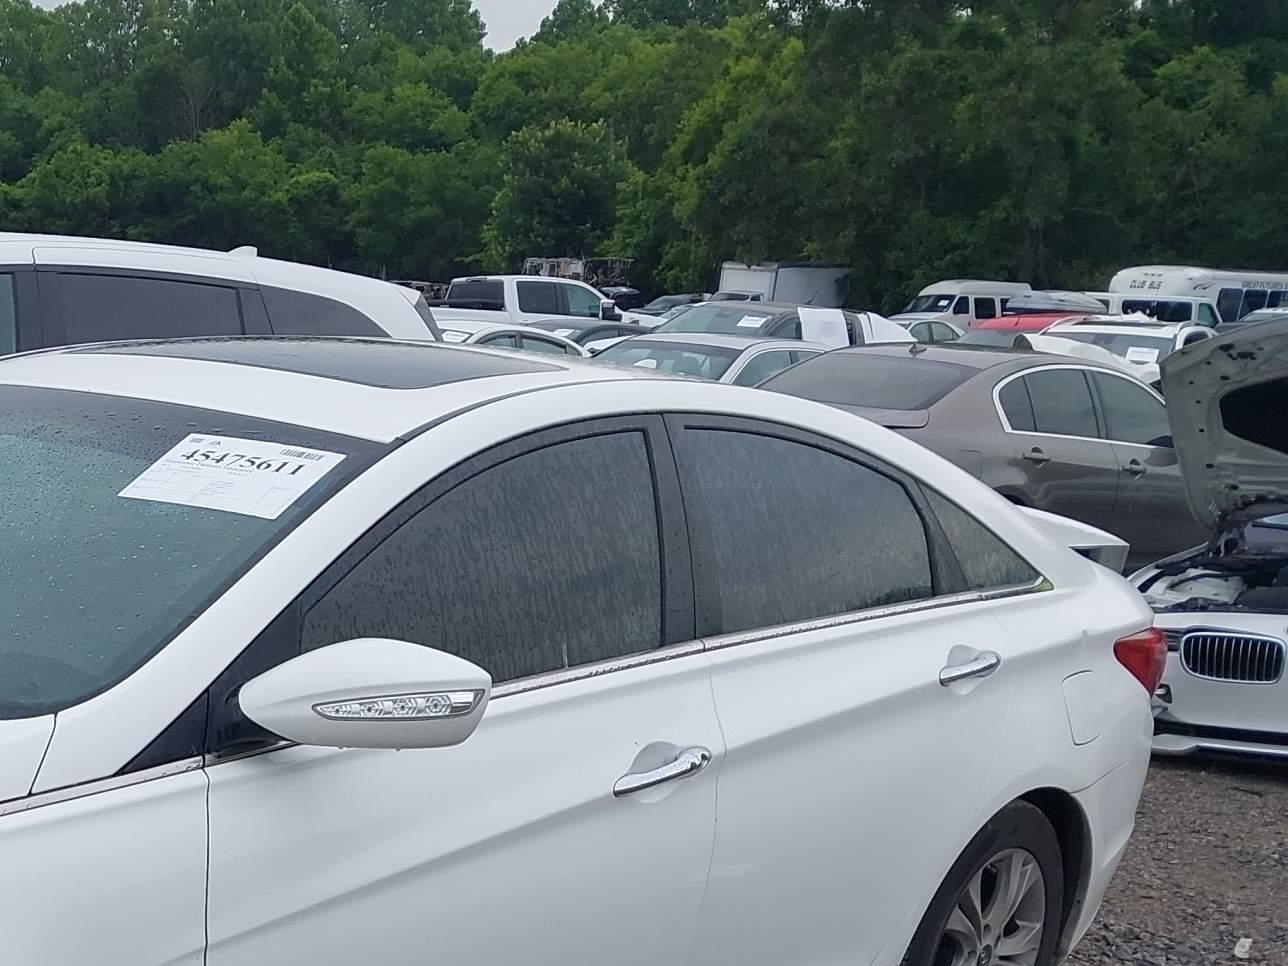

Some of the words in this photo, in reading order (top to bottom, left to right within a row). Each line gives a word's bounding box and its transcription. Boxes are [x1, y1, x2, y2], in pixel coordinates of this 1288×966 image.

[1129, 279, 1147, 289] CLUB
[1148, 280, 1163, 290] BUS
[181, 448, 306, 476] 45475611
